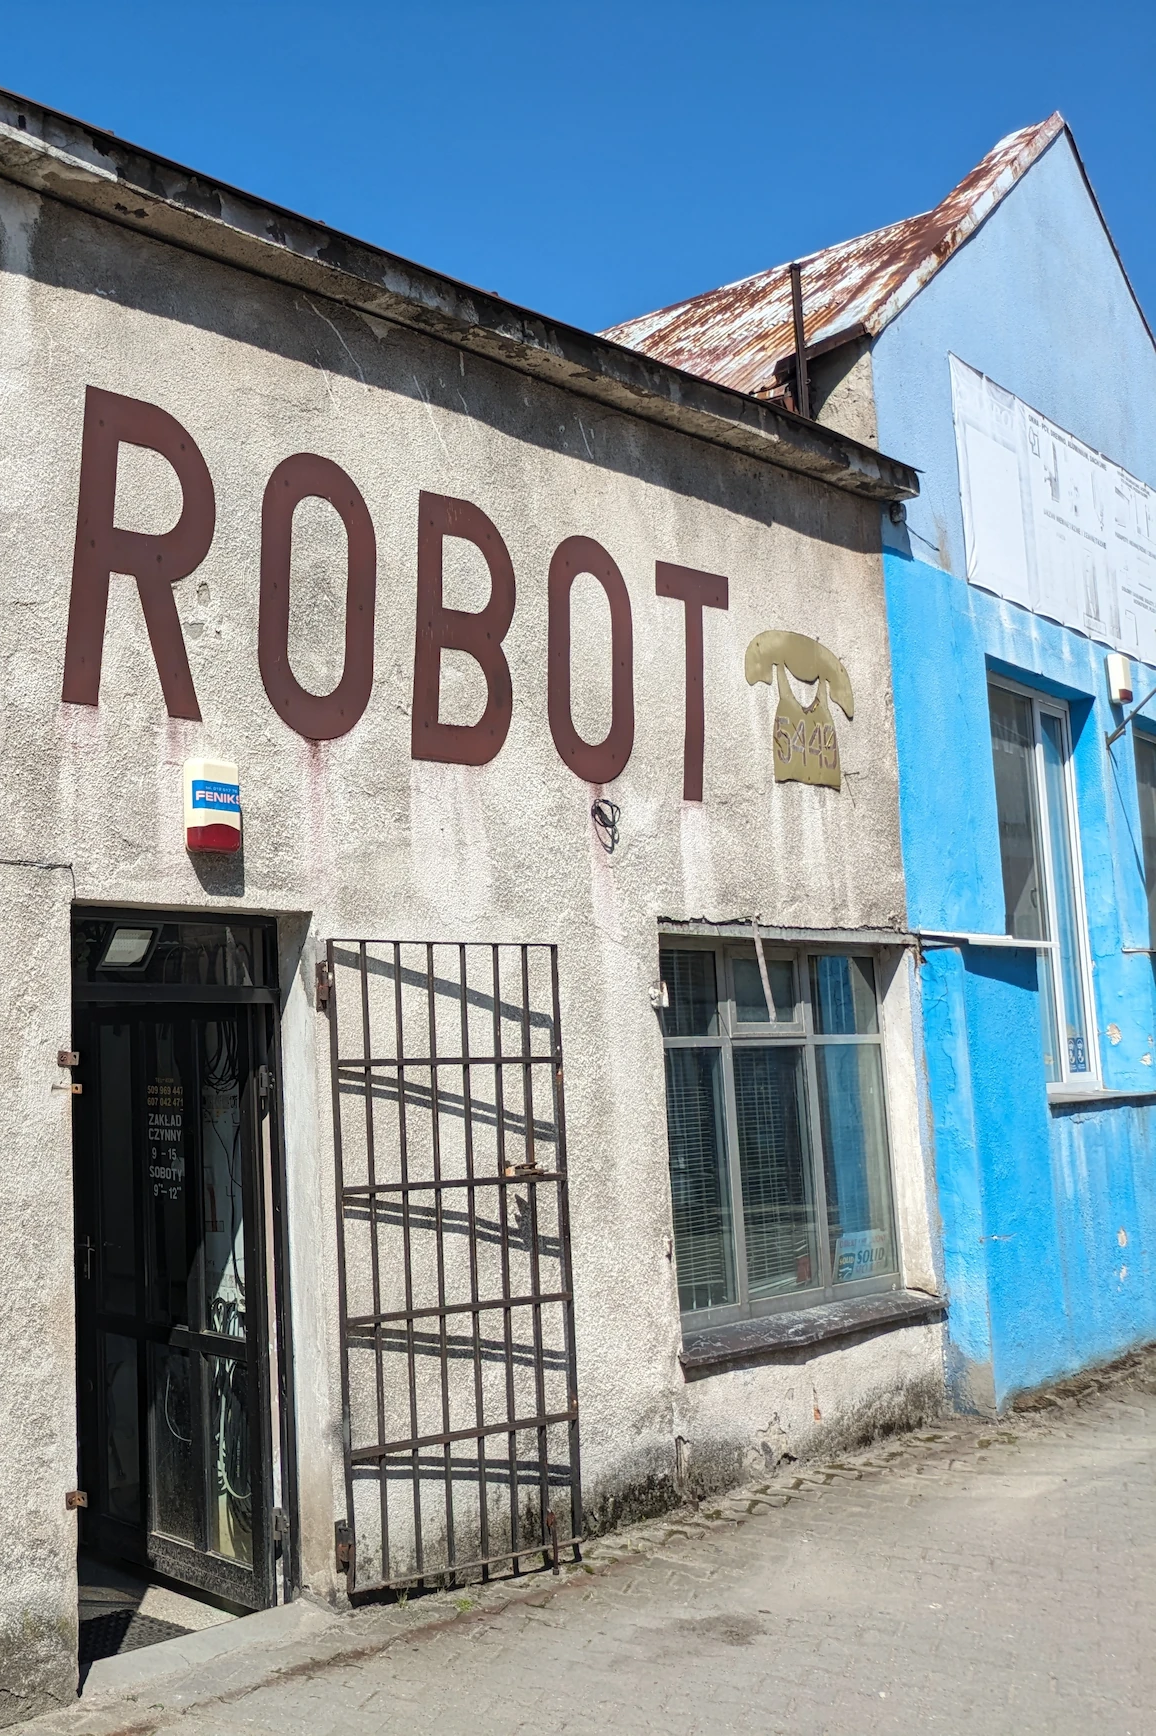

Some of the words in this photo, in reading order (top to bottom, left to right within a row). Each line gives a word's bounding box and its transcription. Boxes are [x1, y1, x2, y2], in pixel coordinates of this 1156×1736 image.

[62, 385, 729, 801] ROBOT
[774, 715, 838, 770] 5449
[147, 1085, 159, 1095] 509
[159, 1085, 172, 1095] 969
[172, 1086, 183, 1095] 447
[147, 1097, 159, 1106] 607
[159, 1097, 172, 1107] 042
[172, 1098, 184, 1107] 471
[148, 1113, 182, 1127] ZAKŁAD
[148, 1128, 182, 1142] CZYNNY
[149, 1165, 182, 1182] SOBOTY
[856, 1247, 885, 1264] SOLID
